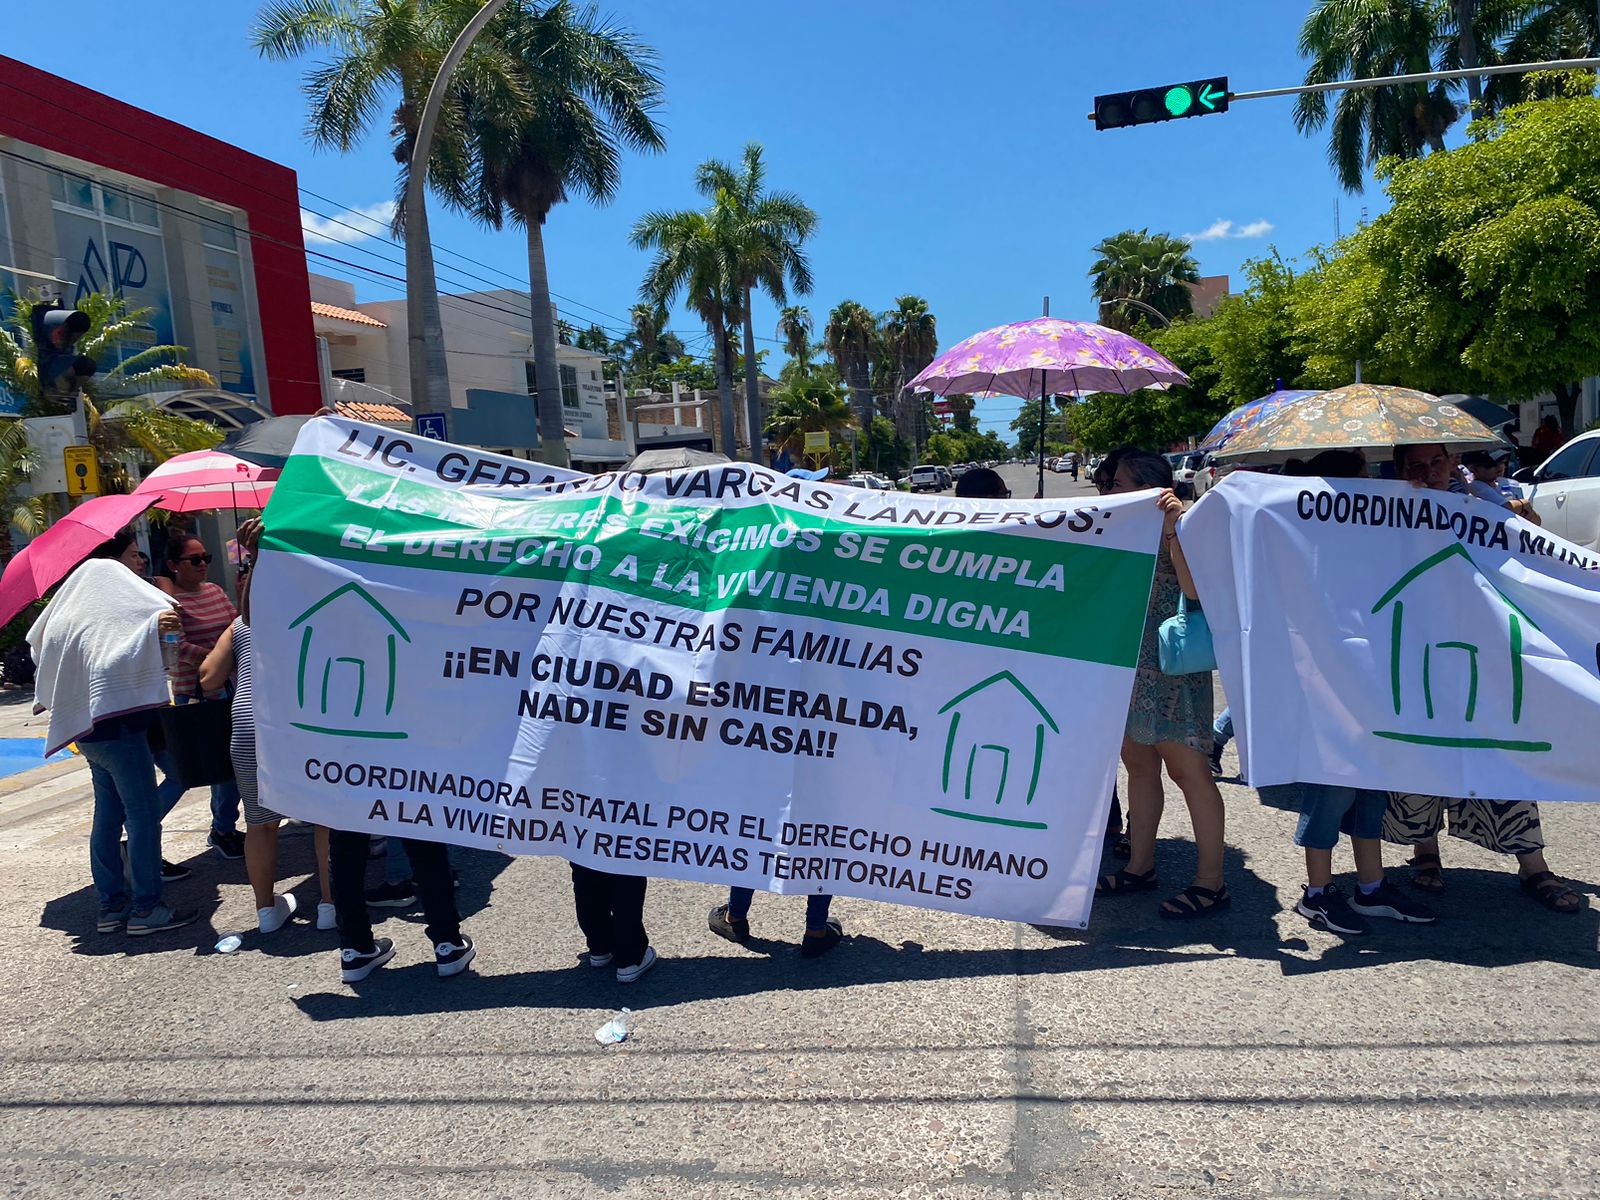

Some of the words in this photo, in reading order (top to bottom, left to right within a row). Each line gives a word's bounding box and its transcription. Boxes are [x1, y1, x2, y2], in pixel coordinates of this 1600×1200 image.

[337, 429, 416, 472] LIC.
[664, 466, 834, 510] VARGAS
[843, 502, 1112, 534] LANDEROS:
[1297, 489, 1510, 551] COORDINADORA
[339, 523, 388, 552] EL
[401, 536, 602, 571] DERECHO
[609, 554, 638, 582] A
[650, 562, 700, 597] LA
[716, 569, 890, 617] VIVIENDA
[903, 594, 1031, 638] DIGNA
[639, 516, 824, 554] EXIGIMOS
[833, 532, 890, 564] SE
[899, 543, 1065, 593] CUMPLA
[455, 587, 542, 623] POR
[547, 597, 742, 653] NUESTRAS
[752, 626, 924, 678] FAMILIAS
[517, 690, 630, 731] NADIE
[641, 709, 709, 742] SIN
[719, 717, 839, 759] CASA!!
[531, 653, 673, 701] CIUDAD
[686, 680, 919, 741] ESMERALDA,
[304, 758, 533, 808] COORDINADORA
[541, 787, 659, 828] ESTATAL
[667, 805, 729, 836] POR
[738, 814, 773, 842] EL
[780, 822, 912, 858] DERECHO
[920, 840, 1049, 880] HUMANO
[368, 799, 390, 821] A
[398, 801, 434, 827] LA
[443, 805, 568, 845] VIVIENDA
[572, 825, 589, 850] Y
[593, 832, 749, 872] RESERVAS
[758, 851, 974, 900] TERRITORIALES
